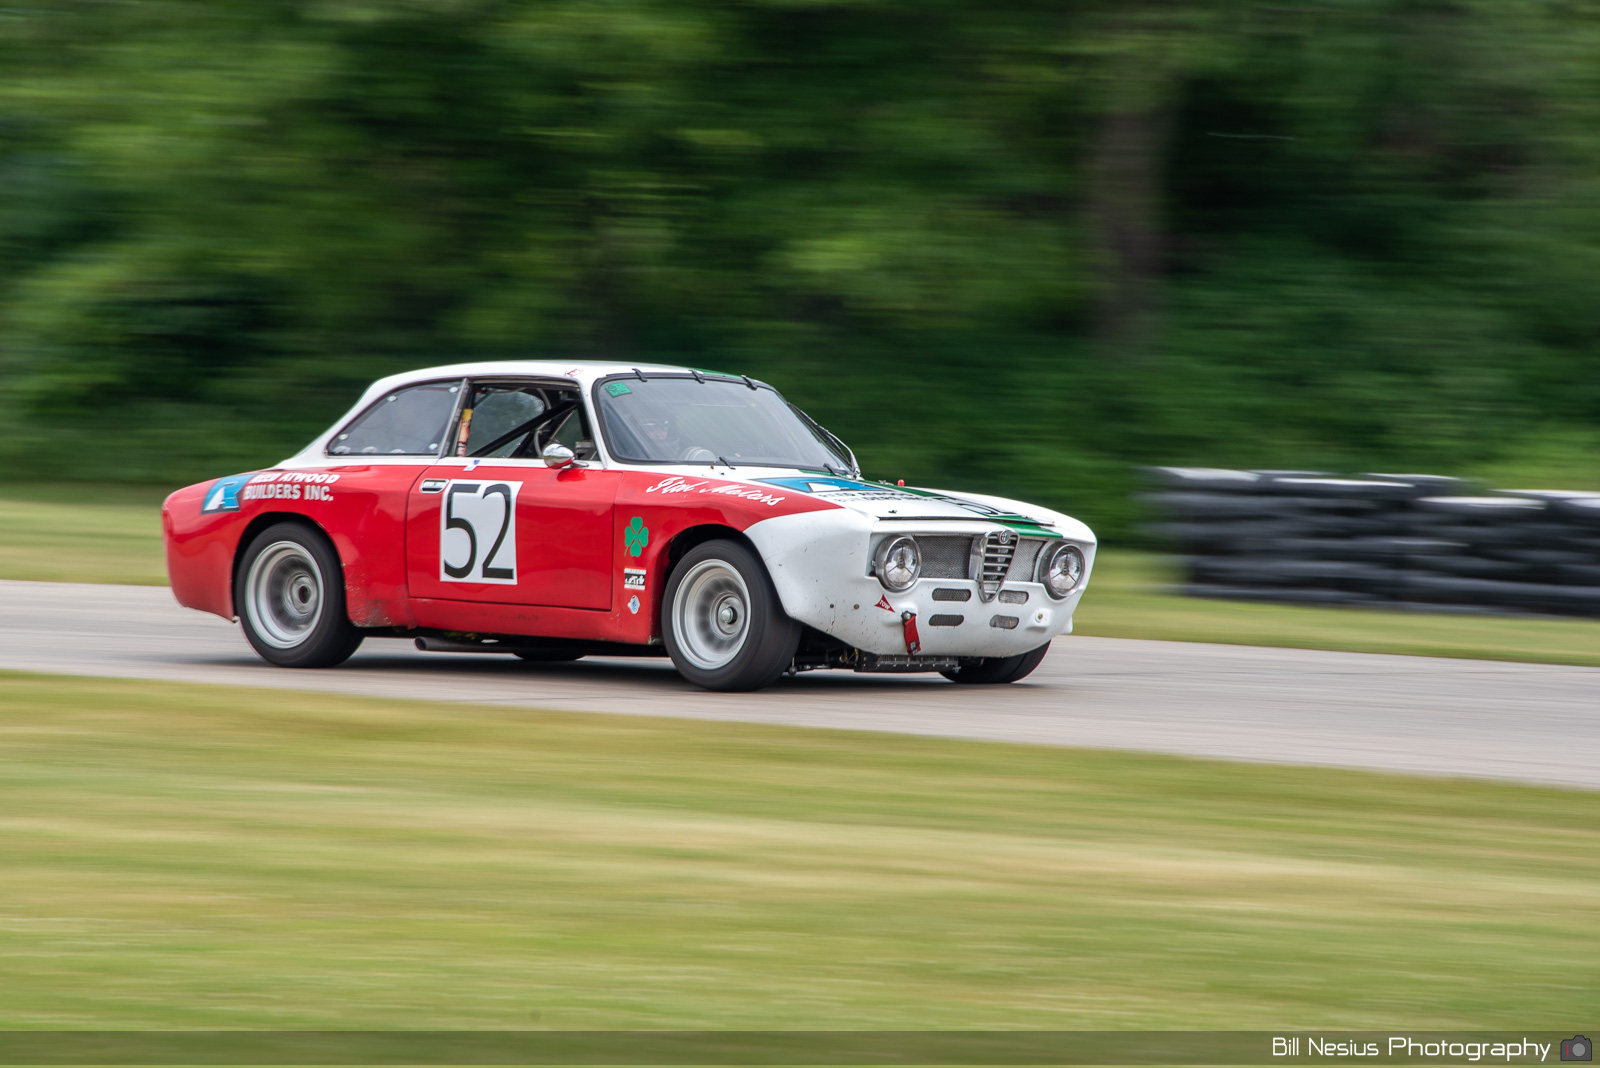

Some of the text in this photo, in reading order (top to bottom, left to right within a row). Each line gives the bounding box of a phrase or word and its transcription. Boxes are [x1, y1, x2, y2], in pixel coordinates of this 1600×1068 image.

[278, 473, 340, 484] ATWOOD
[243, 483, 334, 501] BUILDERS INC.
[444, 483, 514, 579] 52
